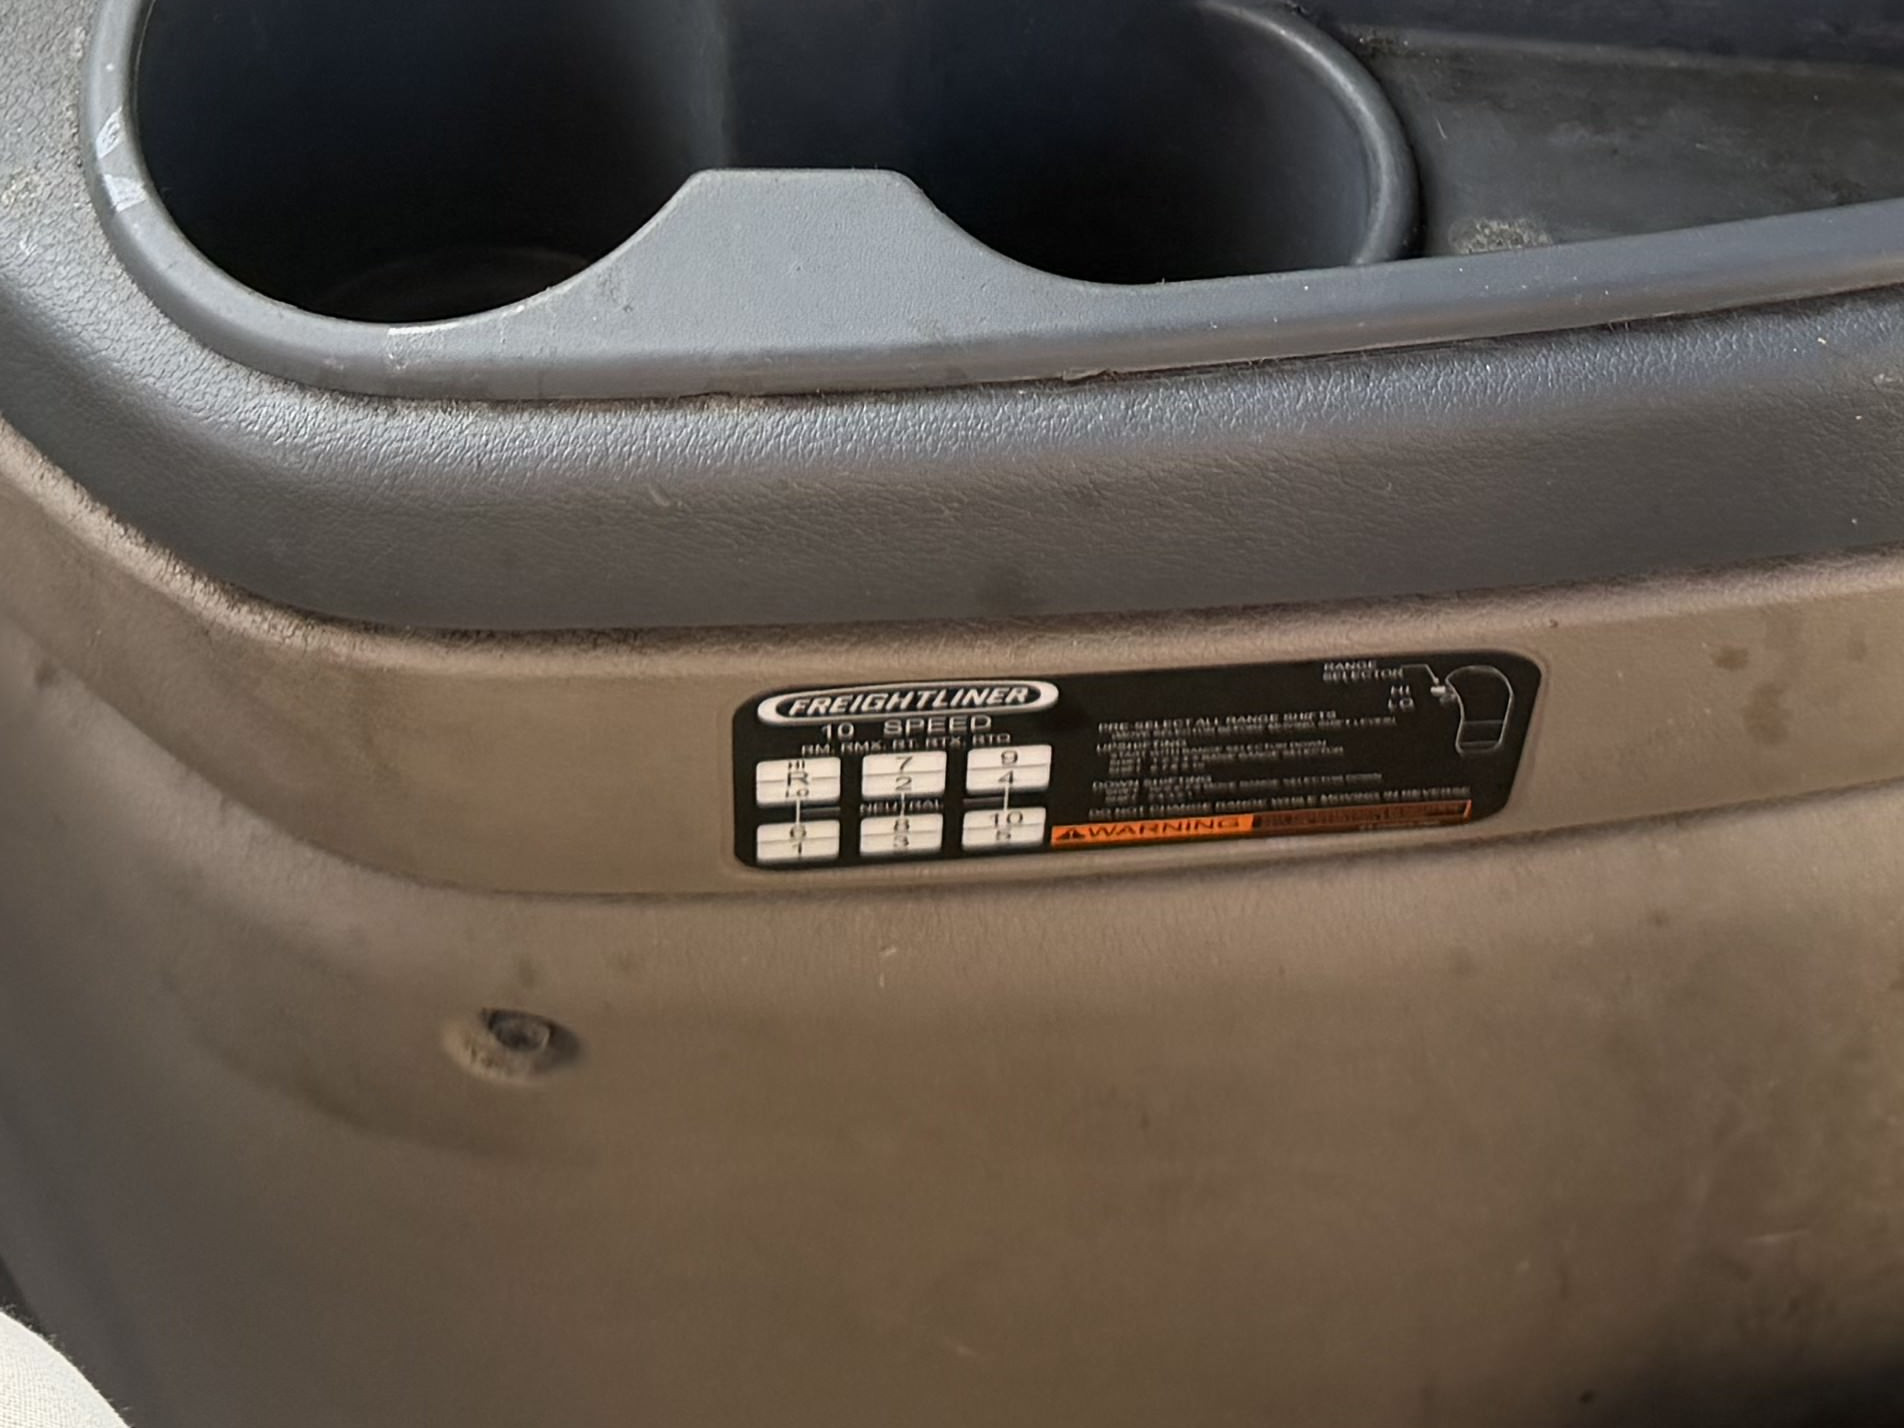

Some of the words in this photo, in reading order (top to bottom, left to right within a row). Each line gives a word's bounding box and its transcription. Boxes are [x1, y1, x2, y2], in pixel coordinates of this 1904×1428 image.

[1324, 661, 1377, 671] RANGE
[788, 686, 1030, 717] FREIGHTLINER
[821, 723, 854, 740] 10
[883, 716, 992, 737] SPEED
[896, 756, 914, 770] 7
[1000, 750, 1018, 764] 9
[786, 771, 809, 786] R
[896, 777, 912, 791] 2
[998, 770, 1014, 784] 4
[1085, 817, 1241, 840] WARNING
